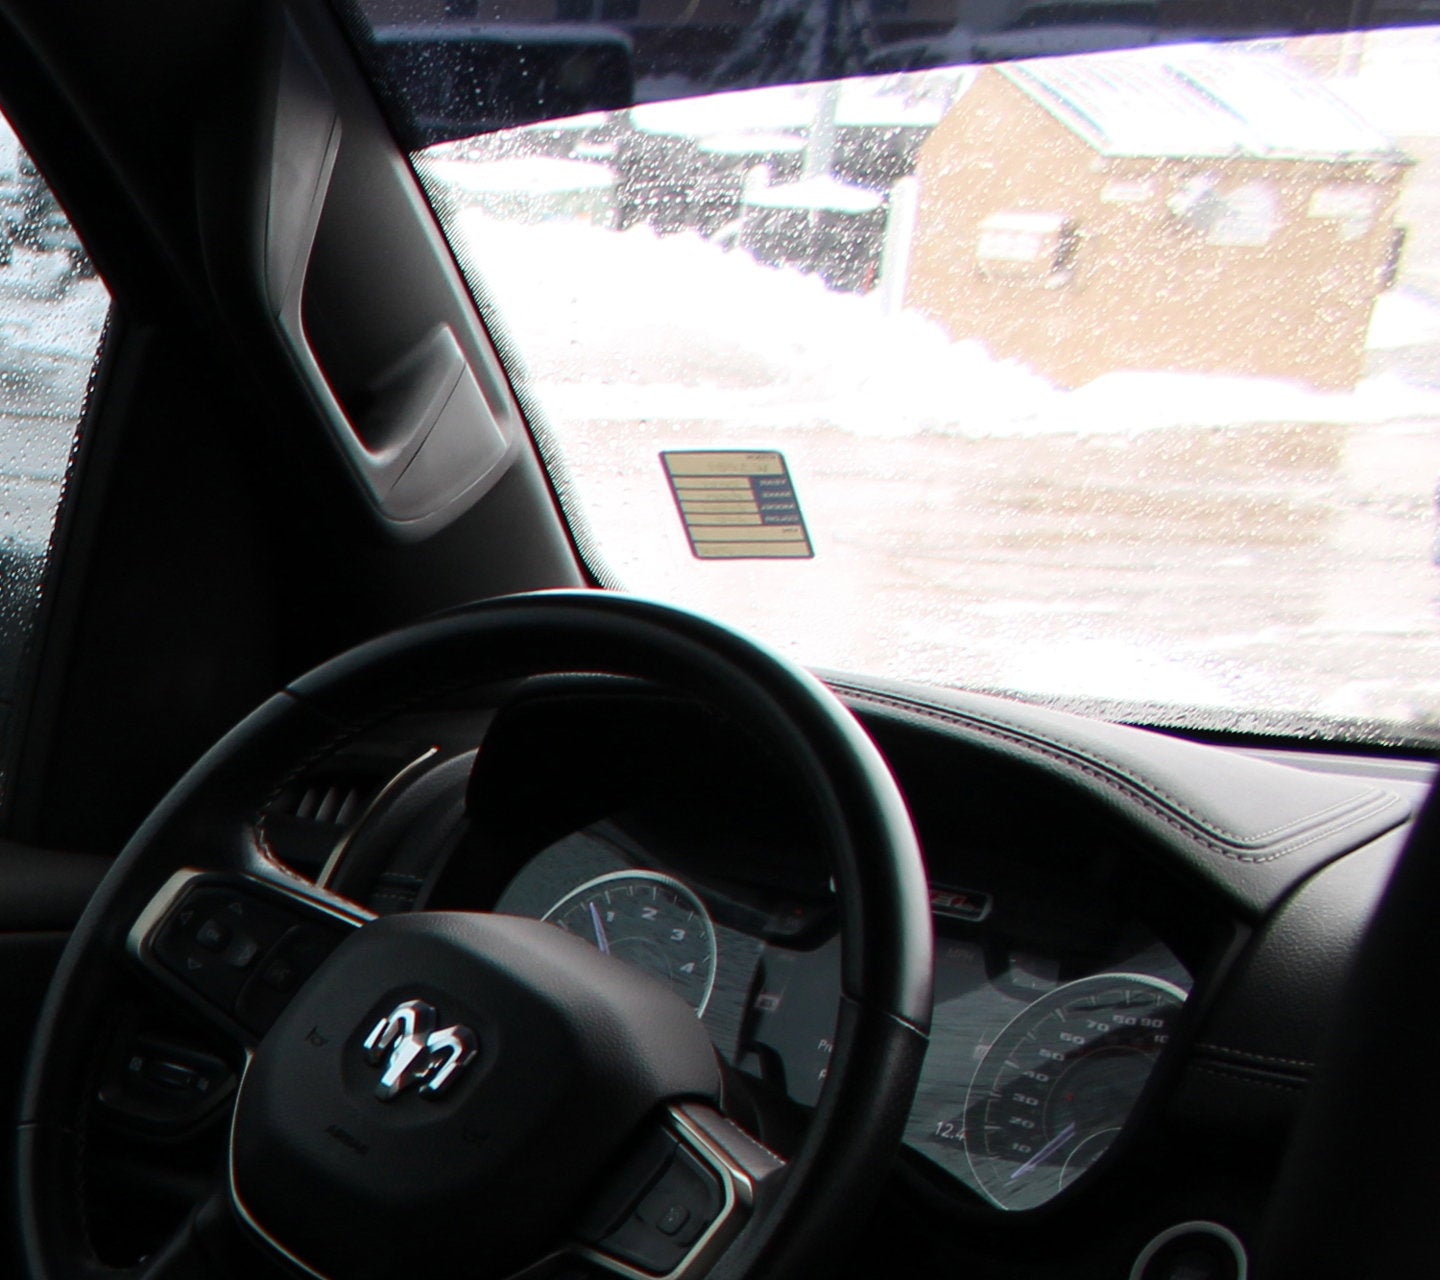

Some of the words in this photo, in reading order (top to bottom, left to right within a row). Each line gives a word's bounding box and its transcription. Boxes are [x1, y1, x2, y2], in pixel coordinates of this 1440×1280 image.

[606, 911, 616, 923] 1
[641, 907, 658, 921] 2
[670, 928, 686, 941] 3
[680, 962, 696, 974] 4
[1086, 1018, 1110, 1032] 70
[1012, 1092, 1039, 1106] 30
[1009, 1115, 1036, 1129] 20
[1012, 1142, 1032, 1154] 10
